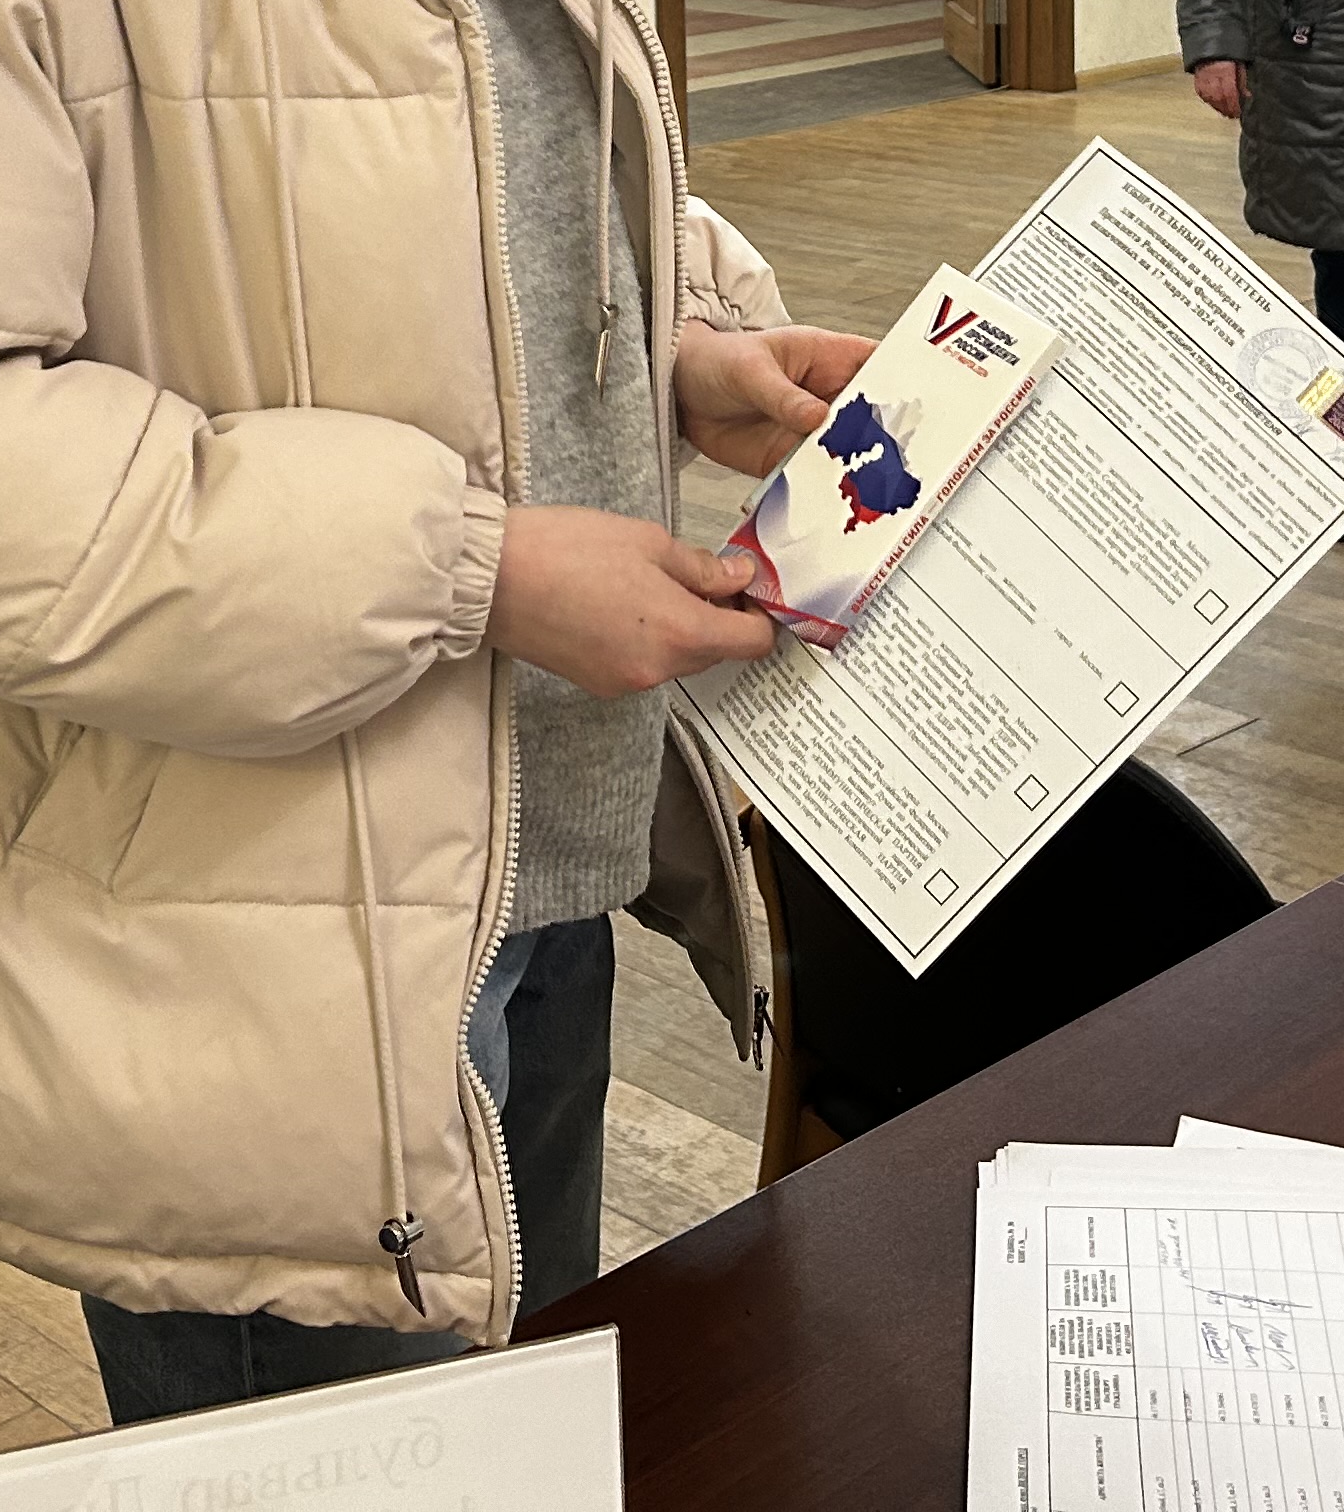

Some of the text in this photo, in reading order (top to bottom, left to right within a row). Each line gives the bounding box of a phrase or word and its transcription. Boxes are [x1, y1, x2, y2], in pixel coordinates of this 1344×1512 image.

[1202, 248, 1274, 313] БЮЛЛЕТЕНЬ
[850, 375, 1037, 614] ВМЕСТЕ МЫ СИЛА ГОЛОСУЕМ ЗА РОССИЮ!
